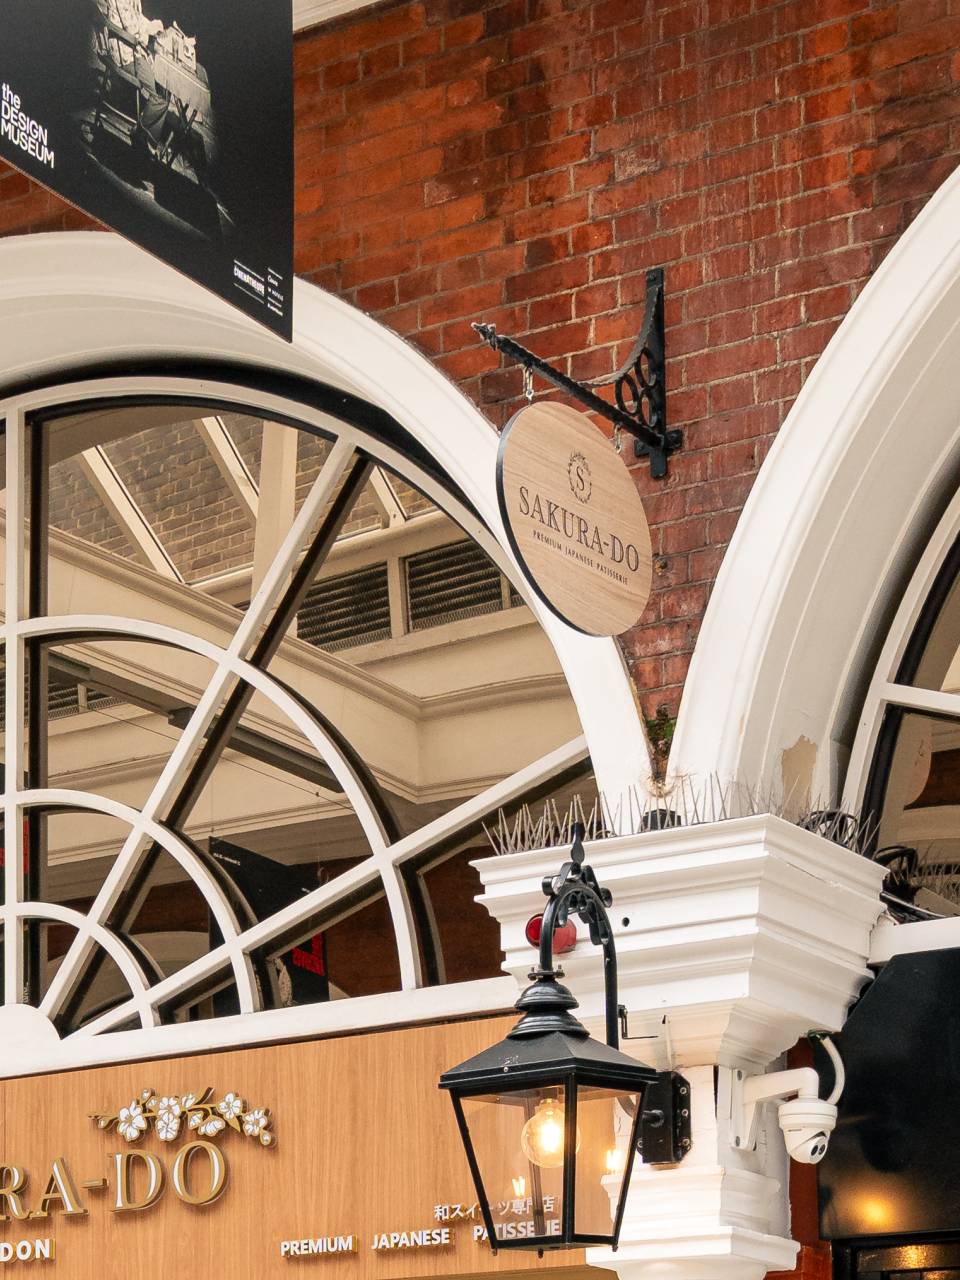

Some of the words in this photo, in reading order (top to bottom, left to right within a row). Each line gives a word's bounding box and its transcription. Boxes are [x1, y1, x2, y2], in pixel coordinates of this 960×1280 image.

[1, 82, 21, 108] the
[0, 118, 55, 169] MUSEUM
[1, 101, 48, 143] DESIGN
[519, 486, 639, 572] SAKURA-DO
[533, 529, 562, 552] PREMIUM
[565, 547, 594, 568] JAPANESE
[596, 563, 628, 586] PATISSERIE
[280, 1235, 357, 1257] PREMIUM
[371, 1227, 451, 1250] JAPANESE
